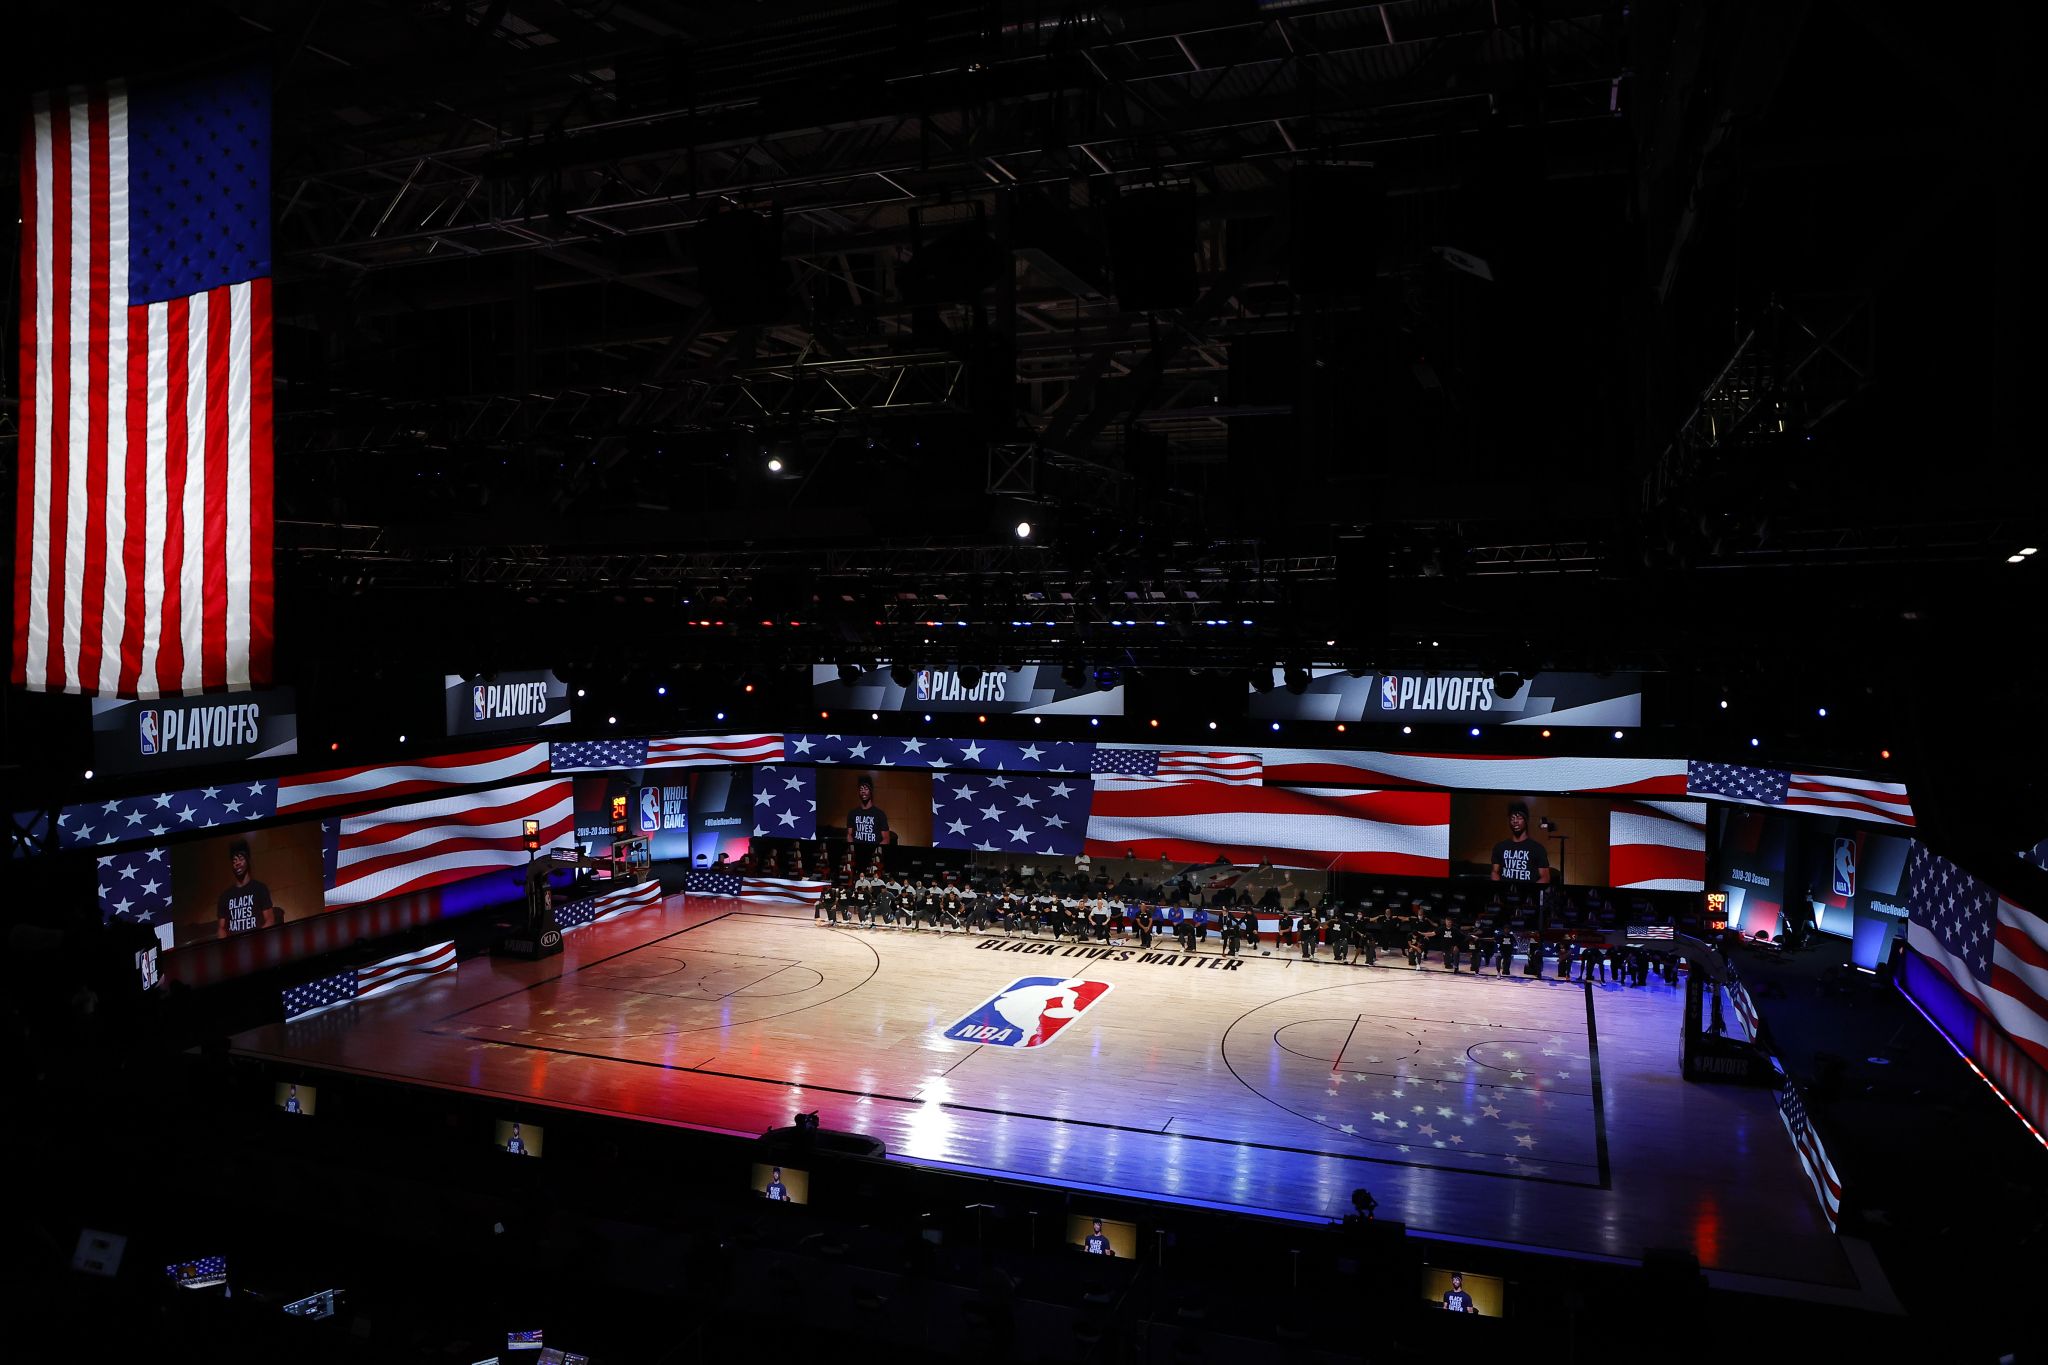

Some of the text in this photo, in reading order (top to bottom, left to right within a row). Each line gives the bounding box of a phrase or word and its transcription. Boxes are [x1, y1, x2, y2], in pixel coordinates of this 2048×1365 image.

[487, 682, 547, 719] PLAYOFFS
[1400, 676, 1494, 711] PLAYOFFS
[161, 703, 260, 752] PLAYOFFS
[613, 805, 624, 819] 24
[663, 800, 681, 815] NEW
[664, 814, 686, 829] GAME
[855, 815, 875, 825] BLACK
[1503, 849, 1530, 861] BLACK
[1752, 873, 1770, 887] Season
[1836, 881, 1847, 892] NBA
[228, 894, 254, 910] BLACK
[1708, 901, 1722, 911] 24
[543, 933, 558, 944] KIA
[975, 939, 1244, 971] BLACK LIVES MATTER
[954, 1024, 1013, 1042] NBA
